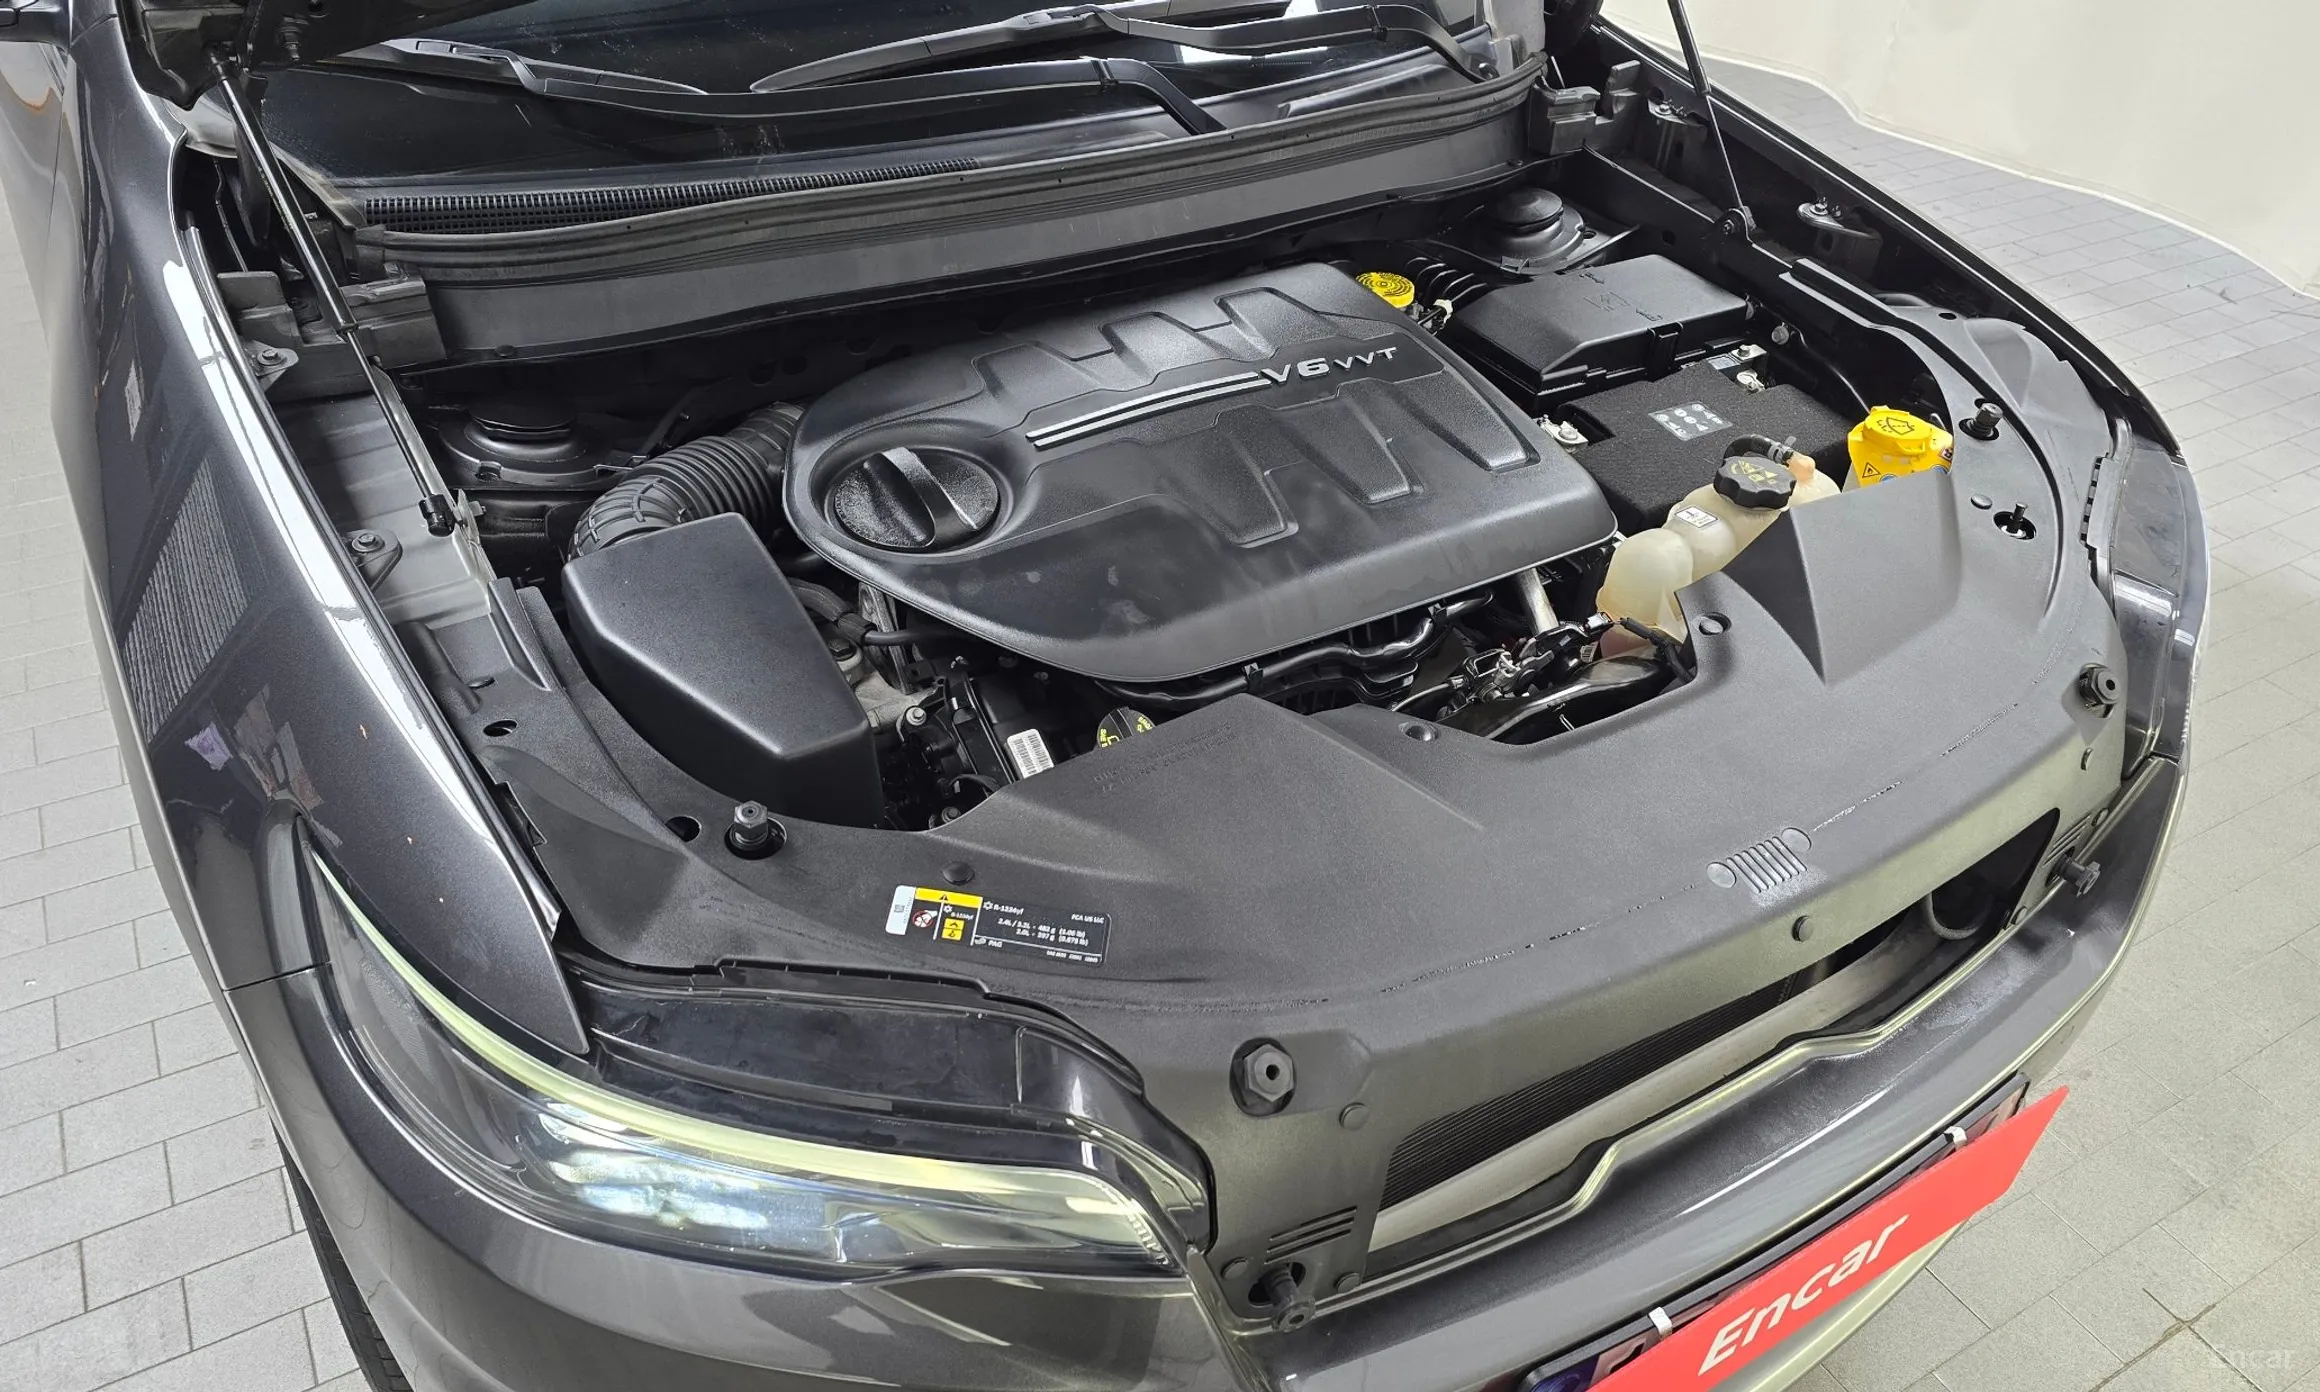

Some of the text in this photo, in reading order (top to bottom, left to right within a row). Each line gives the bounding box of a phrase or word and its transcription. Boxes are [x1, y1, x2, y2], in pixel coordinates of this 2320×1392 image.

[1261, 346, 1397, 383] V6 VVT
[993, 904, 1024, 916] R-1234yf
[1071, 913, 1083, 921] FCA
[1093, 916, 1104, 924] LLC
[988, 940, 1003, 948] PAG
[1697, 1214, 1911, 1376] Encar
